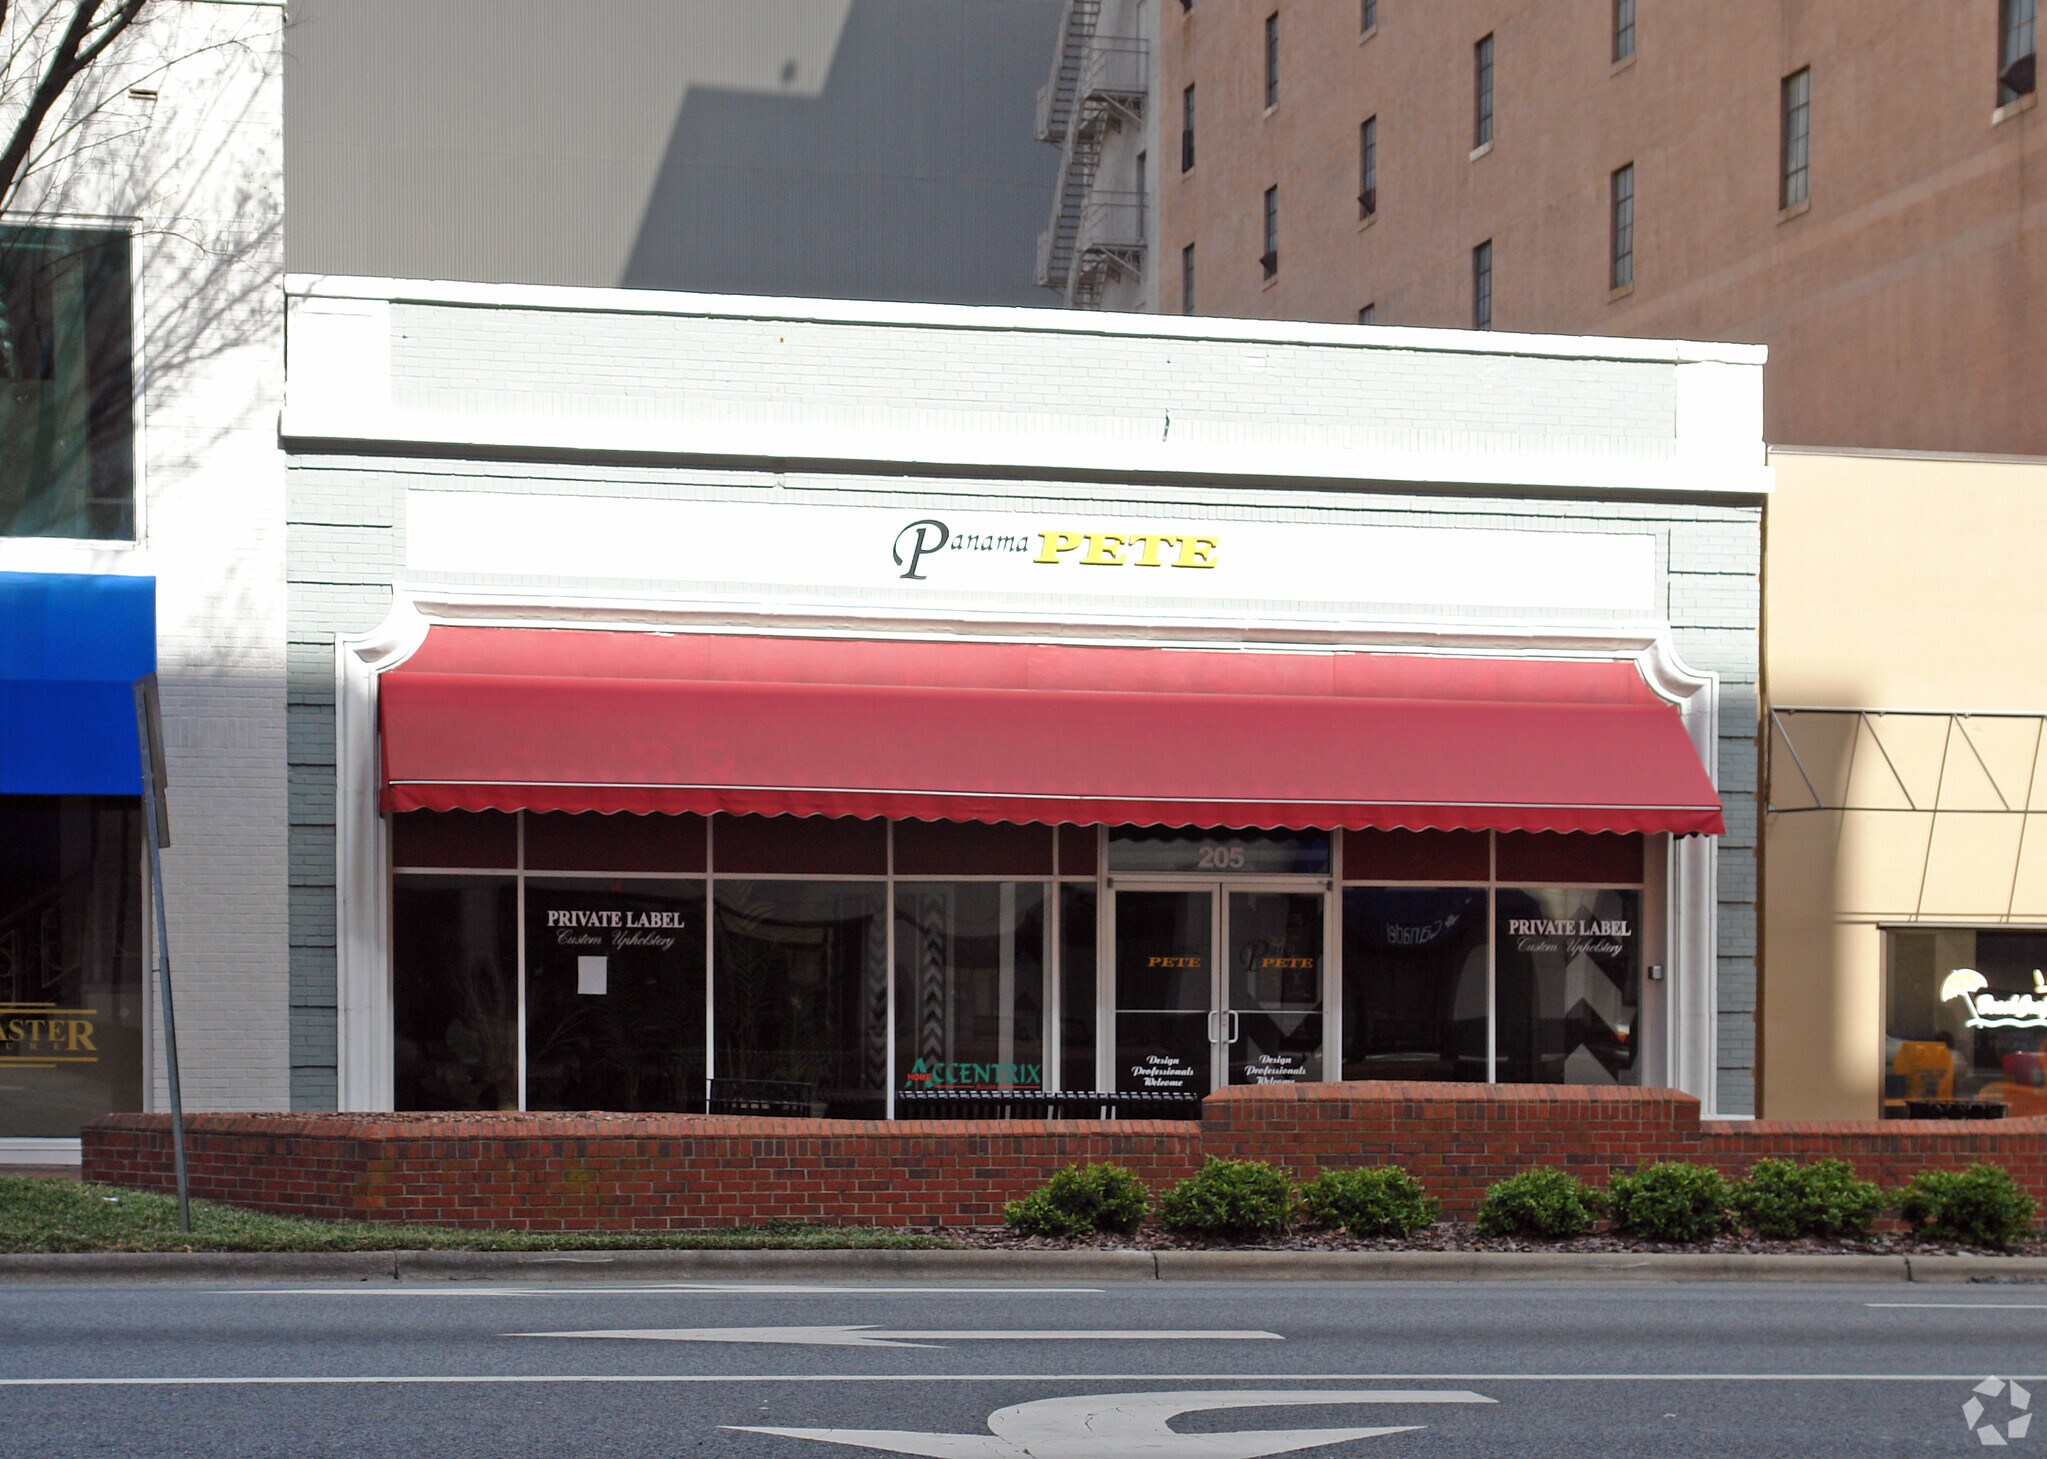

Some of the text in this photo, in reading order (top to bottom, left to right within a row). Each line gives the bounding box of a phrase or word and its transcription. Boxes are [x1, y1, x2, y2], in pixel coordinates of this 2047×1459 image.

[892, 519, 1219, 581] Panama PETE
[1198, 846, 1245, 869] 205
[547, 910, 685, 928] PRIVATE LABEL
[1508, 919, 1632, 936] PRIVATE LABEL
[556, 928, 675, 950] Custom Upholstery
[1517, 936, 1622, 957] Custom Upholstery
[1146, 956, 1201, 968] PETE
[1262, 957, 1314, 969] PETE
[1145, 1055, 1180, 1066] Design
[1258, 1054, 1292, 1065] Design
[905, 1057, 1041, 1088] ACCENTRIX
[1131, 1065, 1194, 1077] Professionals
[1244, 1065, 1306, 1076] Professionals
[1143, 1077, 1183, 1087] Welcome
